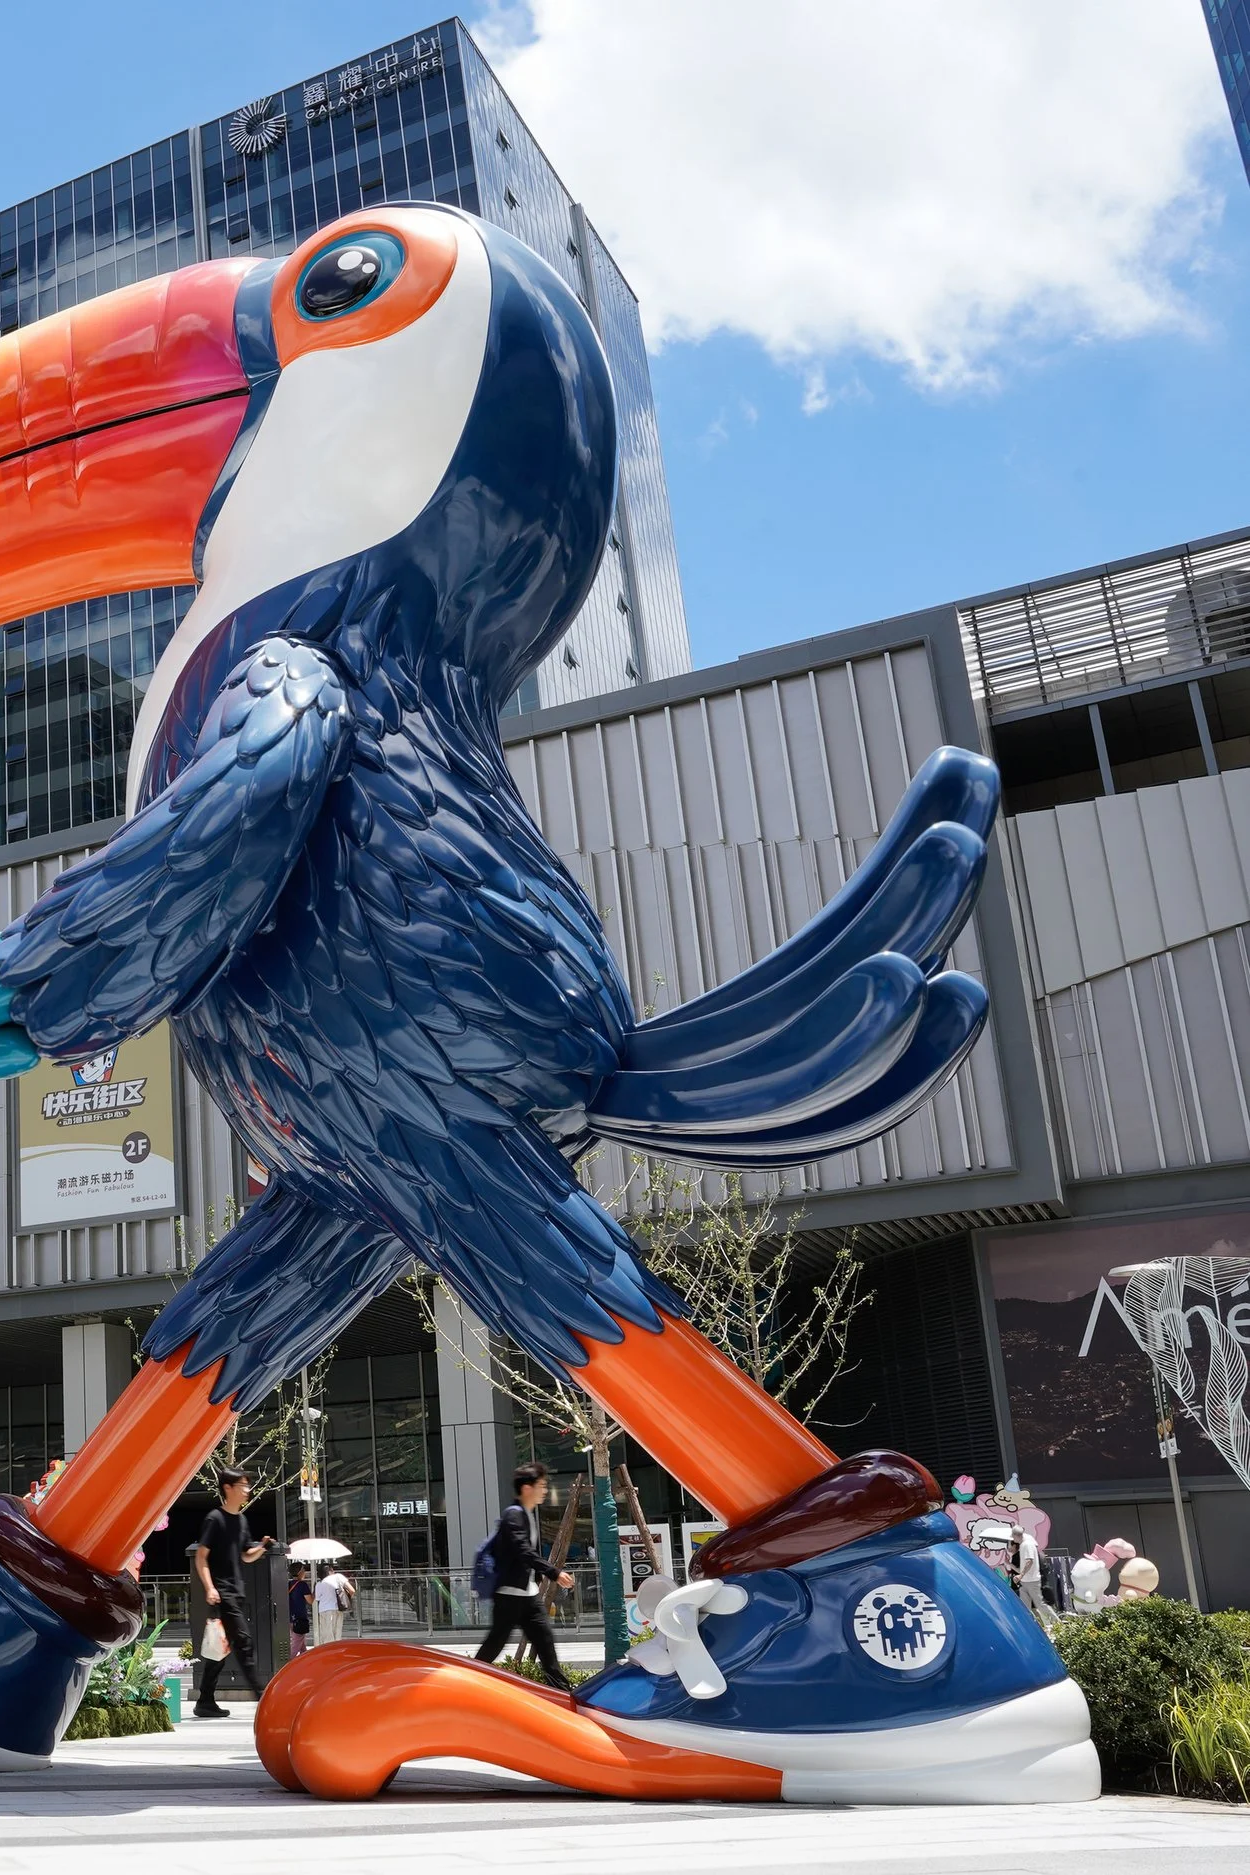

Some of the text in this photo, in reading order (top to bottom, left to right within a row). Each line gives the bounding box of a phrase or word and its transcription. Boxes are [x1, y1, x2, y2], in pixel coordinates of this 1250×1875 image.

[303, 37, 438, 108] 鑫耀中心
[305, 56, 440, 119] GALAXY CENTRE
[42, 1078, 147, 1118] 快乐街区
[126, 1139, 148, 1157] 2F
[57, 1169, 135, 1190] 潮流游乐磁力场
[57, 1190, 82, 1198] Fashion
[104, 1183, 135, 1192] Fabulous
[382, 1500, 429, 1516] 波司登
